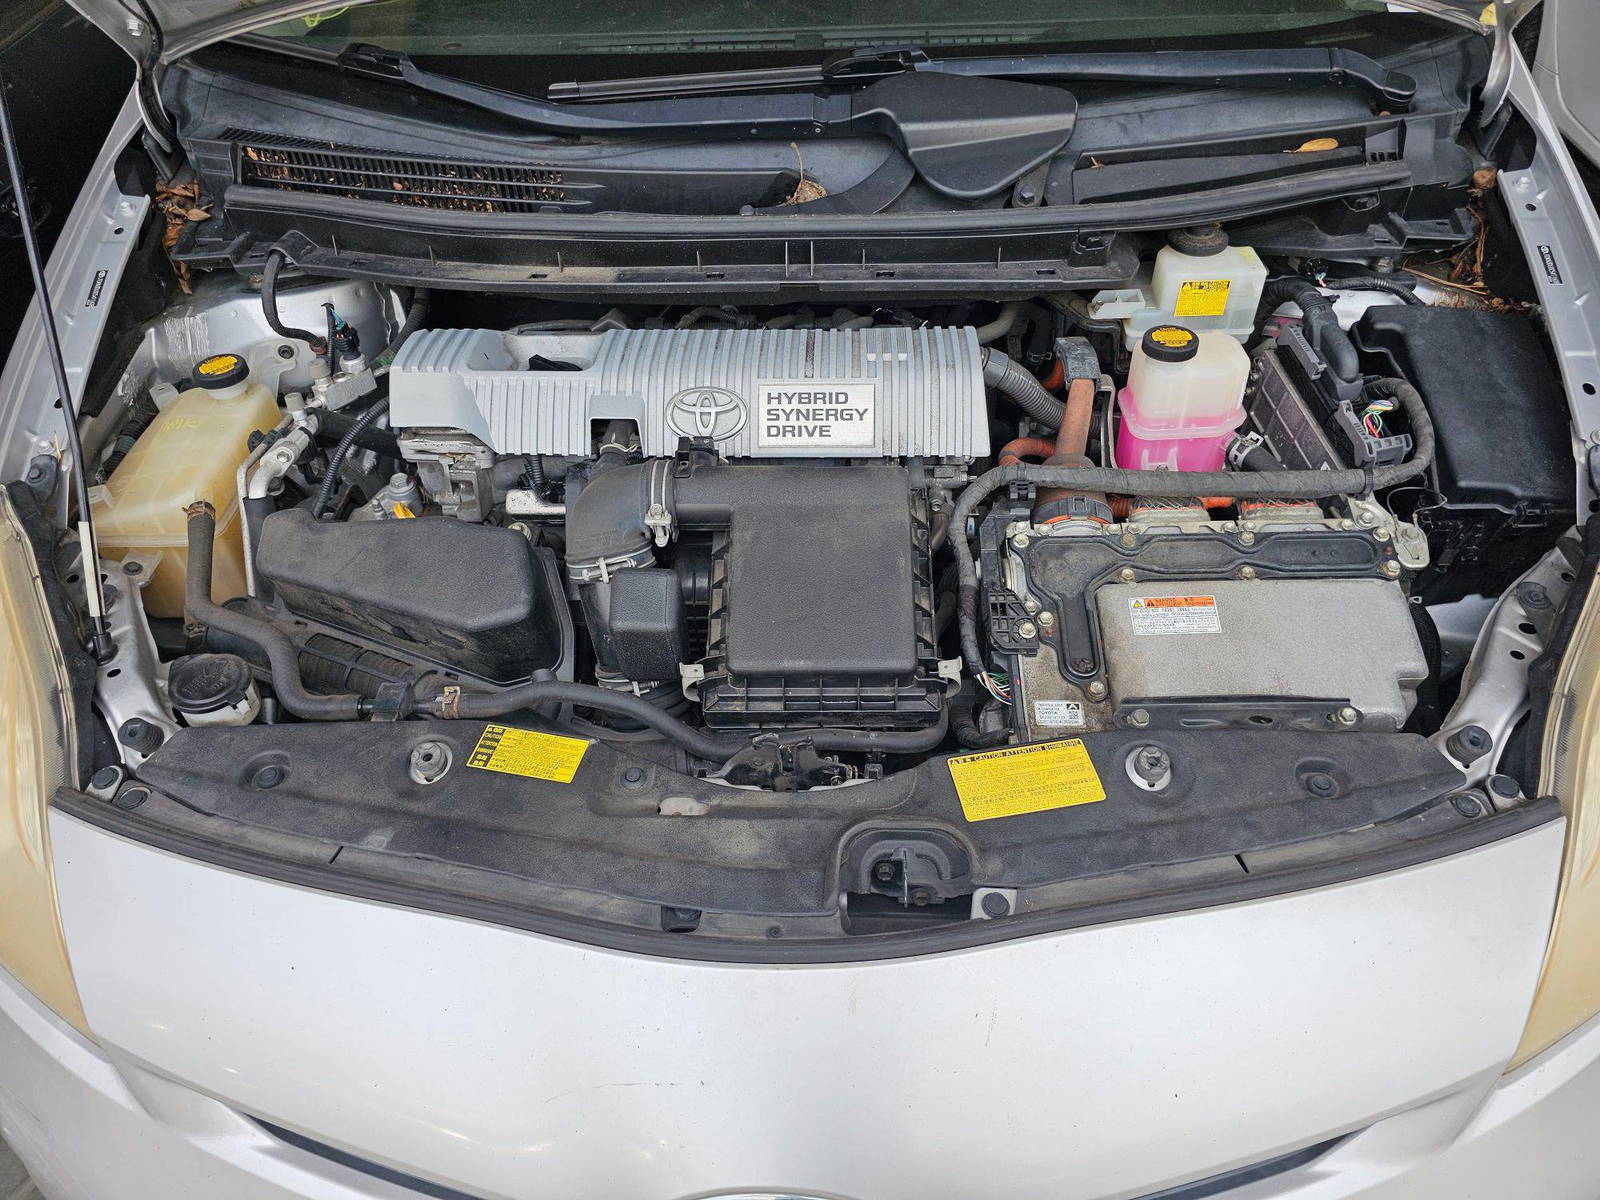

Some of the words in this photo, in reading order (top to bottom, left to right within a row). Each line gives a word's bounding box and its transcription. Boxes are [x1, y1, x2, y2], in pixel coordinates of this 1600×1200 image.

[767, 392, 849, 405] HYBRID
[766, 408, 869, 421] SYNERGY
[766, 425, 832, 438] DRIVE
[974, 753, 1003, 761] CAUTION
[1006, 747, 1042, 757] ATTENTION
